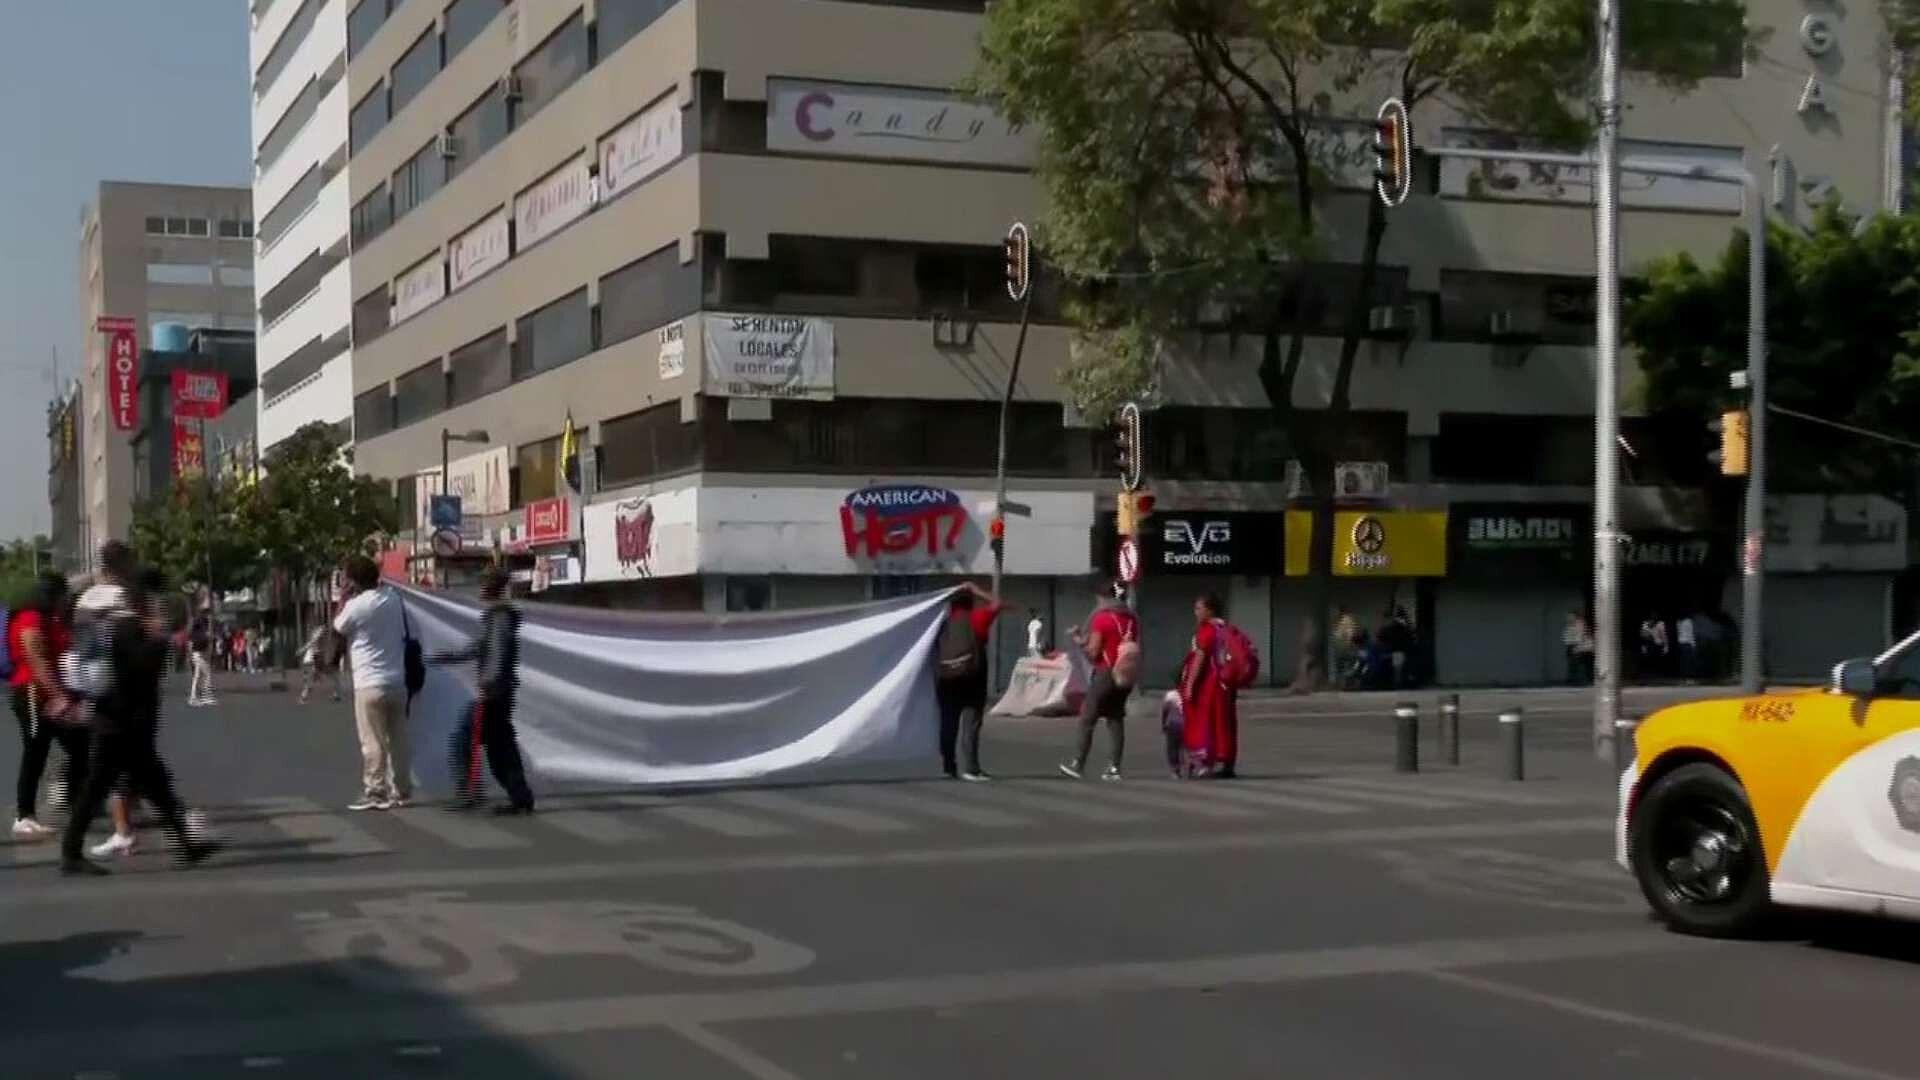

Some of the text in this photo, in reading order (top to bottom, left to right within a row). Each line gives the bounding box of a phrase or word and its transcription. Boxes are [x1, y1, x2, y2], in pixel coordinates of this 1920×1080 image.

[116, 339, 133, 427] HOTEL
[850, 488, 948, 505] AMERICAN
[1164, 552, 1231, 564] Evolution
